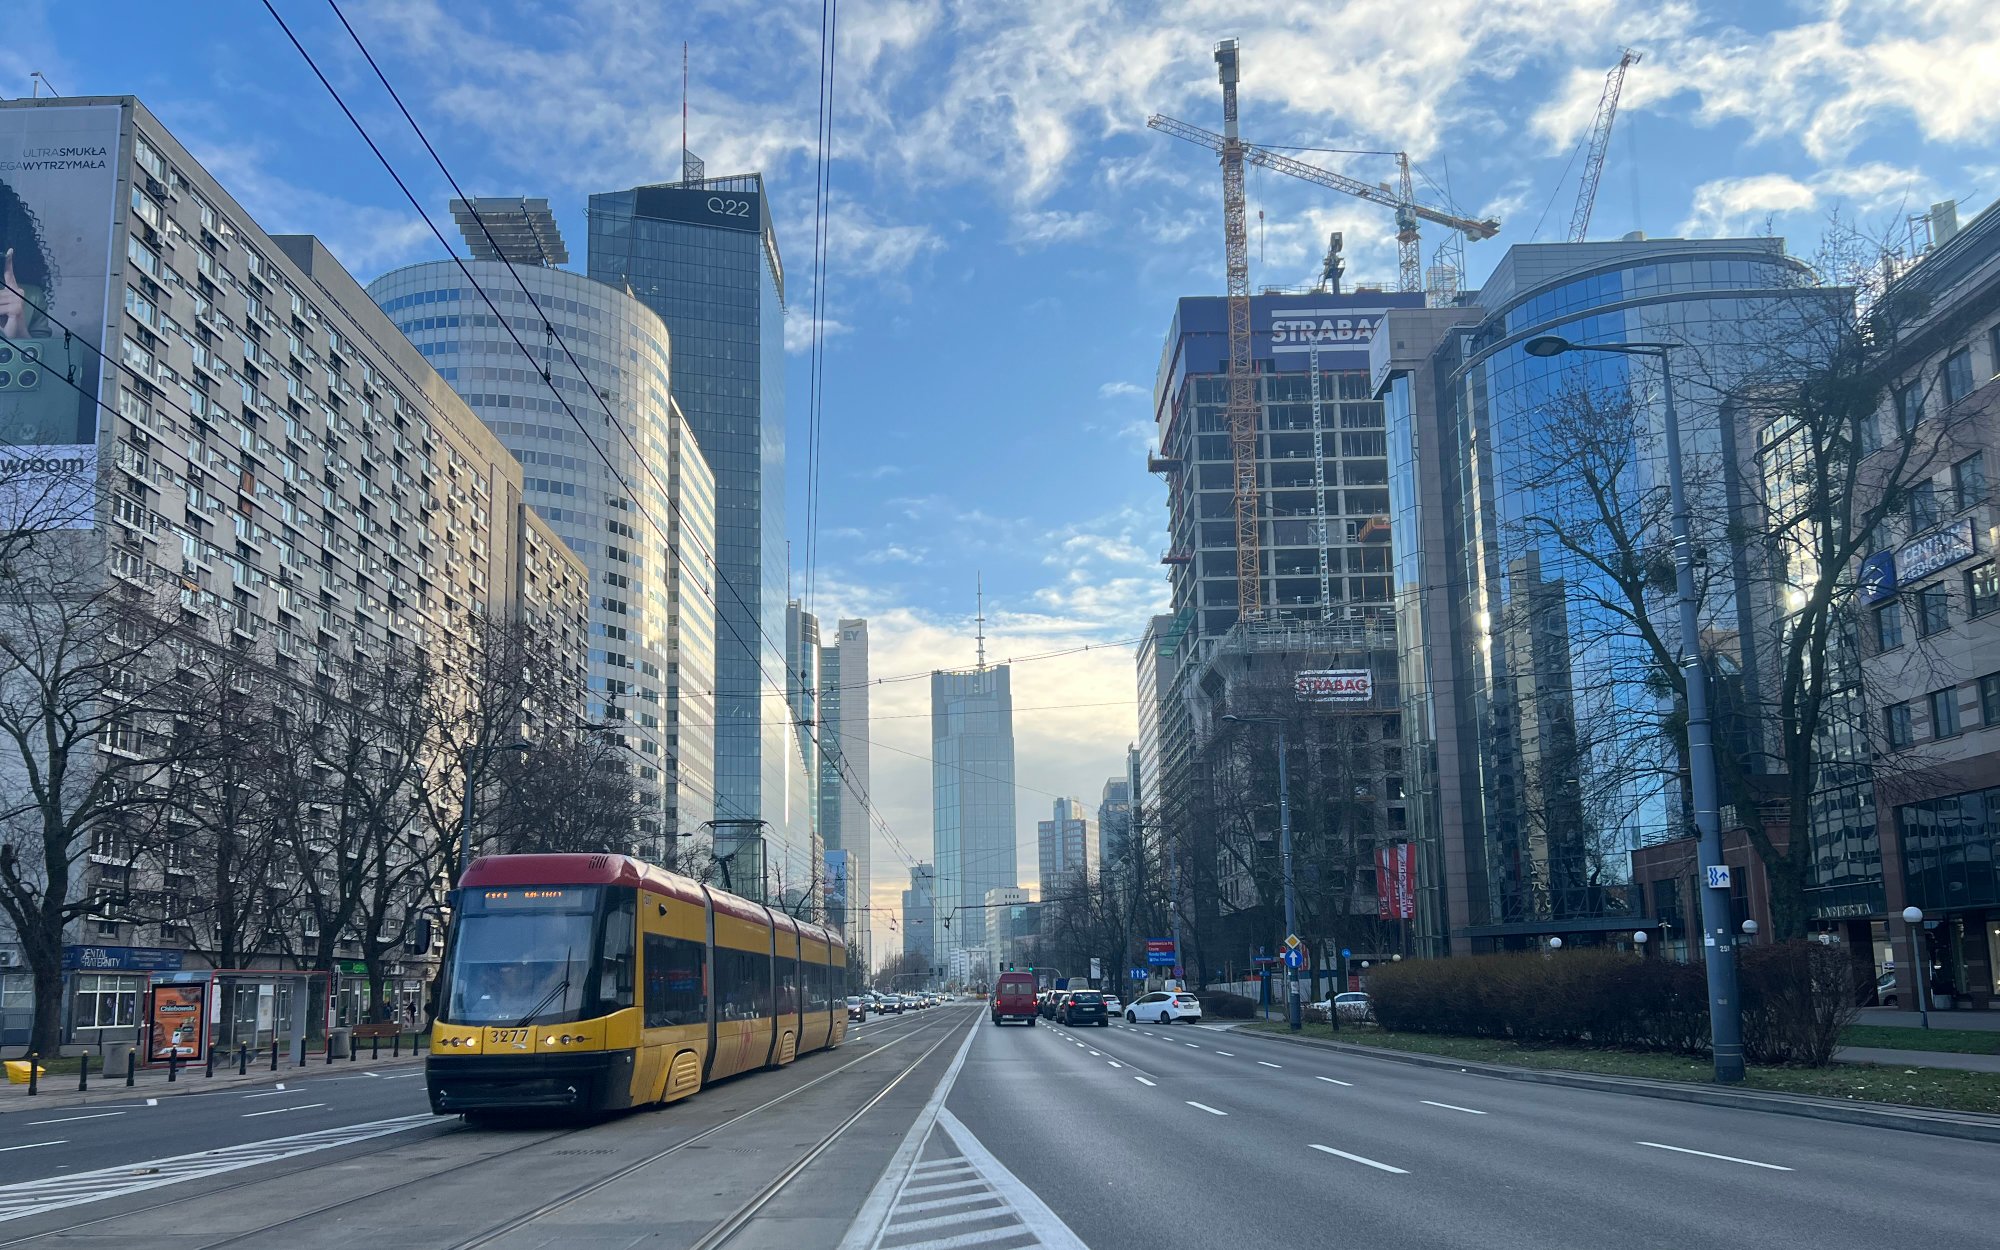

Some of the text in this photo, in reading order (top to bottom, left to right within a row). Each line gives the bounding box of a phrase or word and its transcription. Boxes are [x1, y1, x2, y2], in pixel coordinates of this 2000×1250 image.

[23, 147, 106, 158] ULTRASMUKŁA
[707, 197, 749, 217] Q22
[843, 630, 860, 641] EY
[1298, 679, 1369, 692] STRABAG
[490, 1030, 529, 1044] 3277
